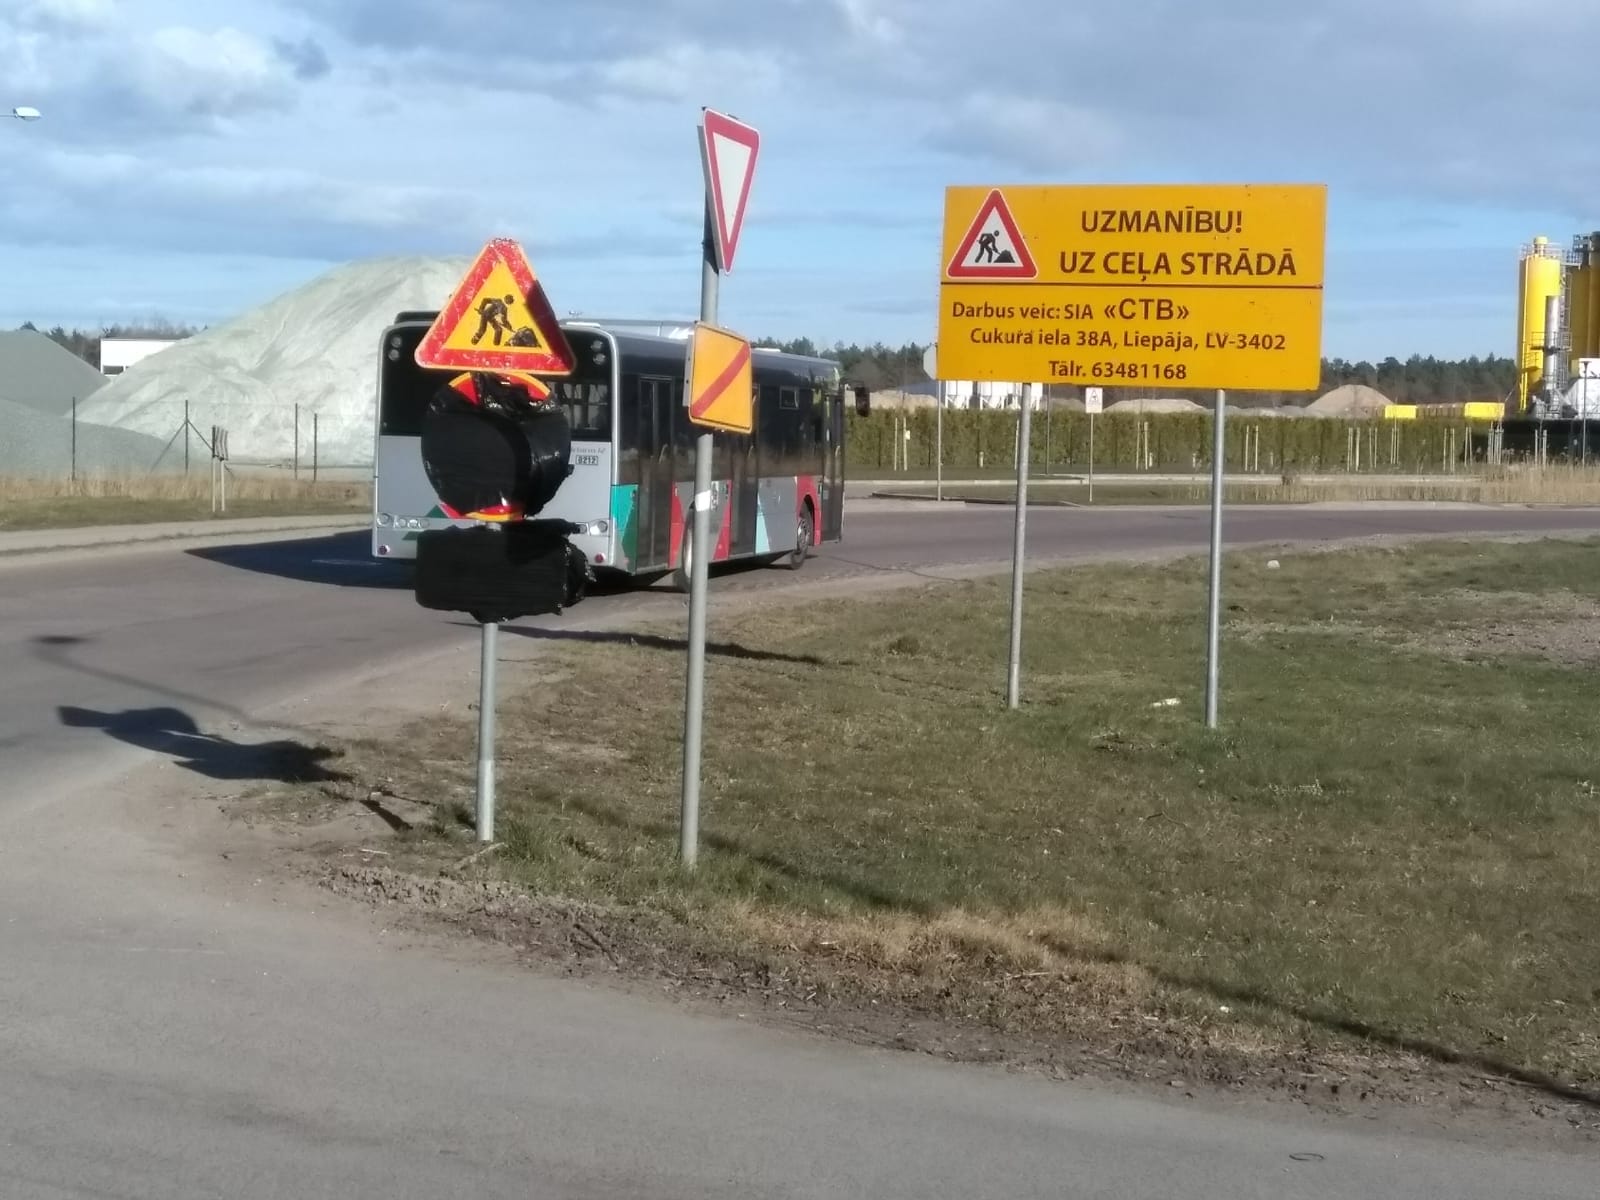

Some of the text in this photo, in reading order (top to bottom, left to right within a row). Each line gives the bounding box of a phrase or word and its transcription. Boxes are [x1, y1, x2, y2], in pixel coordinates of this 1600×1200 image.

[1081, 205, 1243, 234] UZMANĪBU!
[1060, 248, 1297, 282] UZ CEĻA STRĀDĀ
[952, 301, 1015, 319] Darbus
[1064, 304, 1094, 320] SIA
[1104, 298, 1190, 321] «CTB»
[970, 328, 1286, 352] Cukura iela 38A, Liepāja, LV-3402
[1049, 360, 1187, 380] Tālr. 63481168
